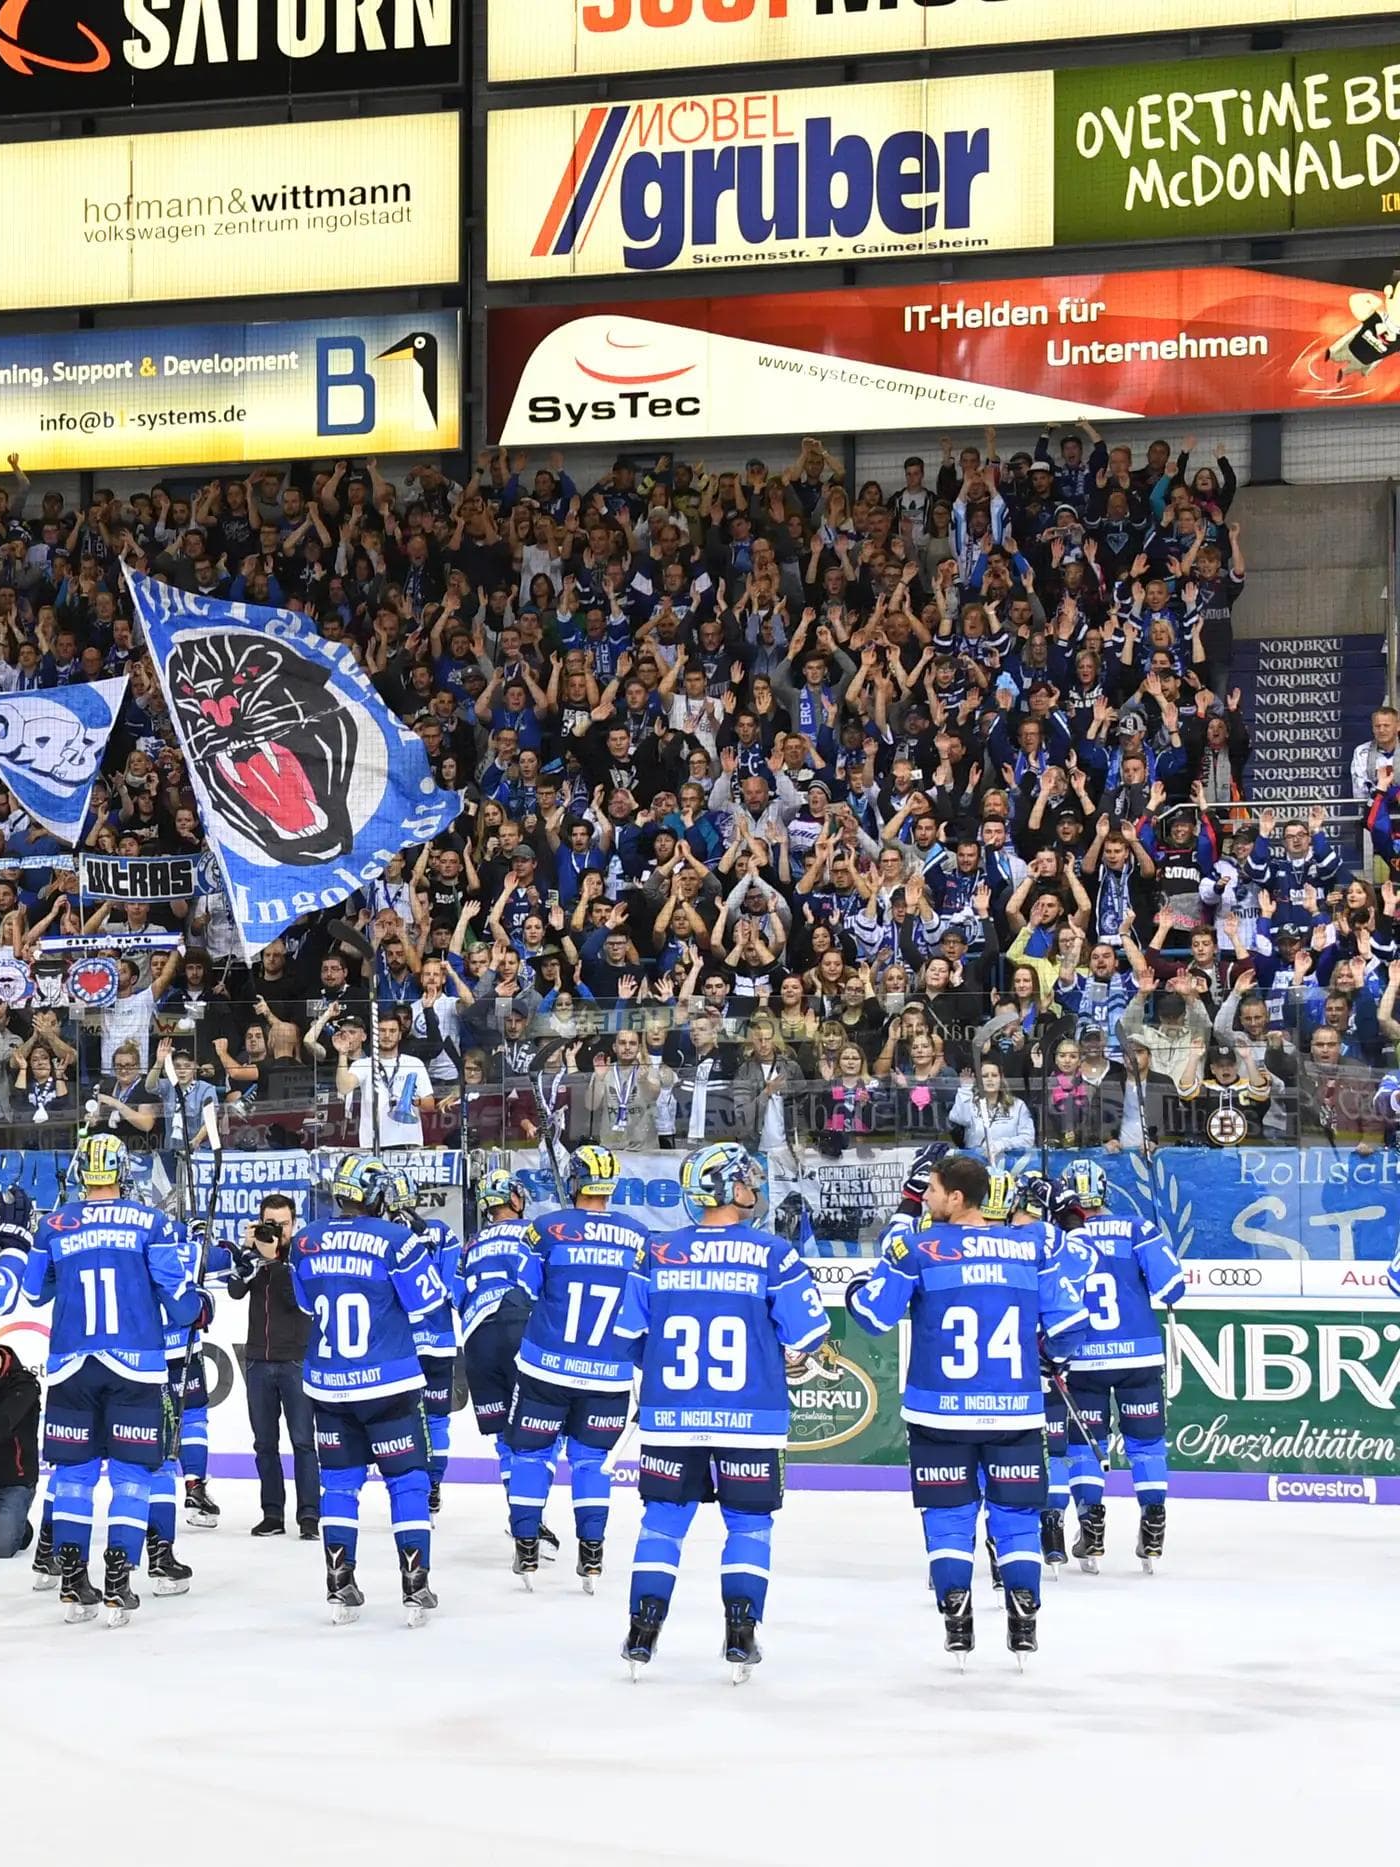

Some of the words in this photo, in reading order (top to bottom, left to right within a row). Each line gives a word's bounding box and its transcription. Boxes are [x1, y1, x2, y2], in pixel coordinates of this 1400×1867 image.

[632, 95, 794, 147] MÖBEL
[620, 116, 990, 270] gruber
[83, 221, 205, 244] volkswagen
[213, 215, 298, 237] zentrum
[307, 206, 412, 231] ingolstadt
[692, 249, 811, 265] Siemensstr.
[818, 246, 829, 258] 7
[852, 236, 989, 256] Gaimersheim
[903, 300, 1048, 333] IT-Helden
[1057, 297, 1106, 324] für
[1046, 333, 1269, 368] Unternehmen
[52, 359, 133, 385] Support
[139, 357, 157, 378] &
[163, 352, 298, 379] Development
[757, 354, 997, 413] www.systec-computer.de
[1259, 638, 1344, 654] NORDBRÄU
[1258, 656, 1344, 671] NORDBRÄU
[1256, 673, 1342, 688] NORDBRÄU
[1255, 691, 1341, 707] NORDBRÄU
[1254, 709, 1342, 725] NORDBRÄU
[1255, 727, 1343, 743] NORDBRÄU
[1254, 746, 1343, 762] NORDBRÄU
[1253, 765, 1343, 781] NORDBRÄU
[1252, 784, 1342, 800] NORDBRÄU
[81, 1205, 155, 1231] SATURN
[59, 1230, 138, 1255] SCHOPPER
[320, 1230, 390, 1259] SATURN
[583, 1221, 646, 1251] SATURN
[567, 1247, 625, 1267] TATICEK
[690, 1239, 770, 1268] SATURN
[962, 1236, 1037, 1261] SATURN
[309, 1256, 373, 1277] MAULDIN
[961, 1263, 1008, 1285] KOHL
[656, 1270, 759, 1294] GREILINGER
[79, 1268, 120, 1337] 11
[563, 1281, 622, 1347] 17
[314, 1292, 372, 1359] 20
[662, 1315, 748, 1392] 39
[940, 1305, 1024, 1380] 34
[540, 1353, 560, 1368] ERC
[563, 1358, 619, 1377] INGOLSTADT
[787, 1389, 862, 1410] NBRÄU
[938, 1395, 960, 1411] ERC
[965, 1395, 1031, 1411] INGOLSTADT
[1120, 1401, 1160, 1416] CINQUE
[521, 1414, 562, 1432] CINQUE
[586, 1414, 625, 1428] CINQUE
[654, 1411, 676, 1427] ERC
[680, 1411, 754, 1429] INGOLSTADT
[46, 1422, 90, 1441] CINQUE
[112, 1423, 159, 1441] CINQUE
[1176, 1414, 1395, 1464] Spezialitäten
[371, 1434, 415, 1456] CINQUE
[640, 1453, 684, 1477] CINQUE
[719, 1459, 771, 1477] CINQUE
[916, 1466, 968, 1482] CINQUE
[988, 1463, 1041, 1480] CINQUE
[1277, 1478, 1363, 1499] covestro
